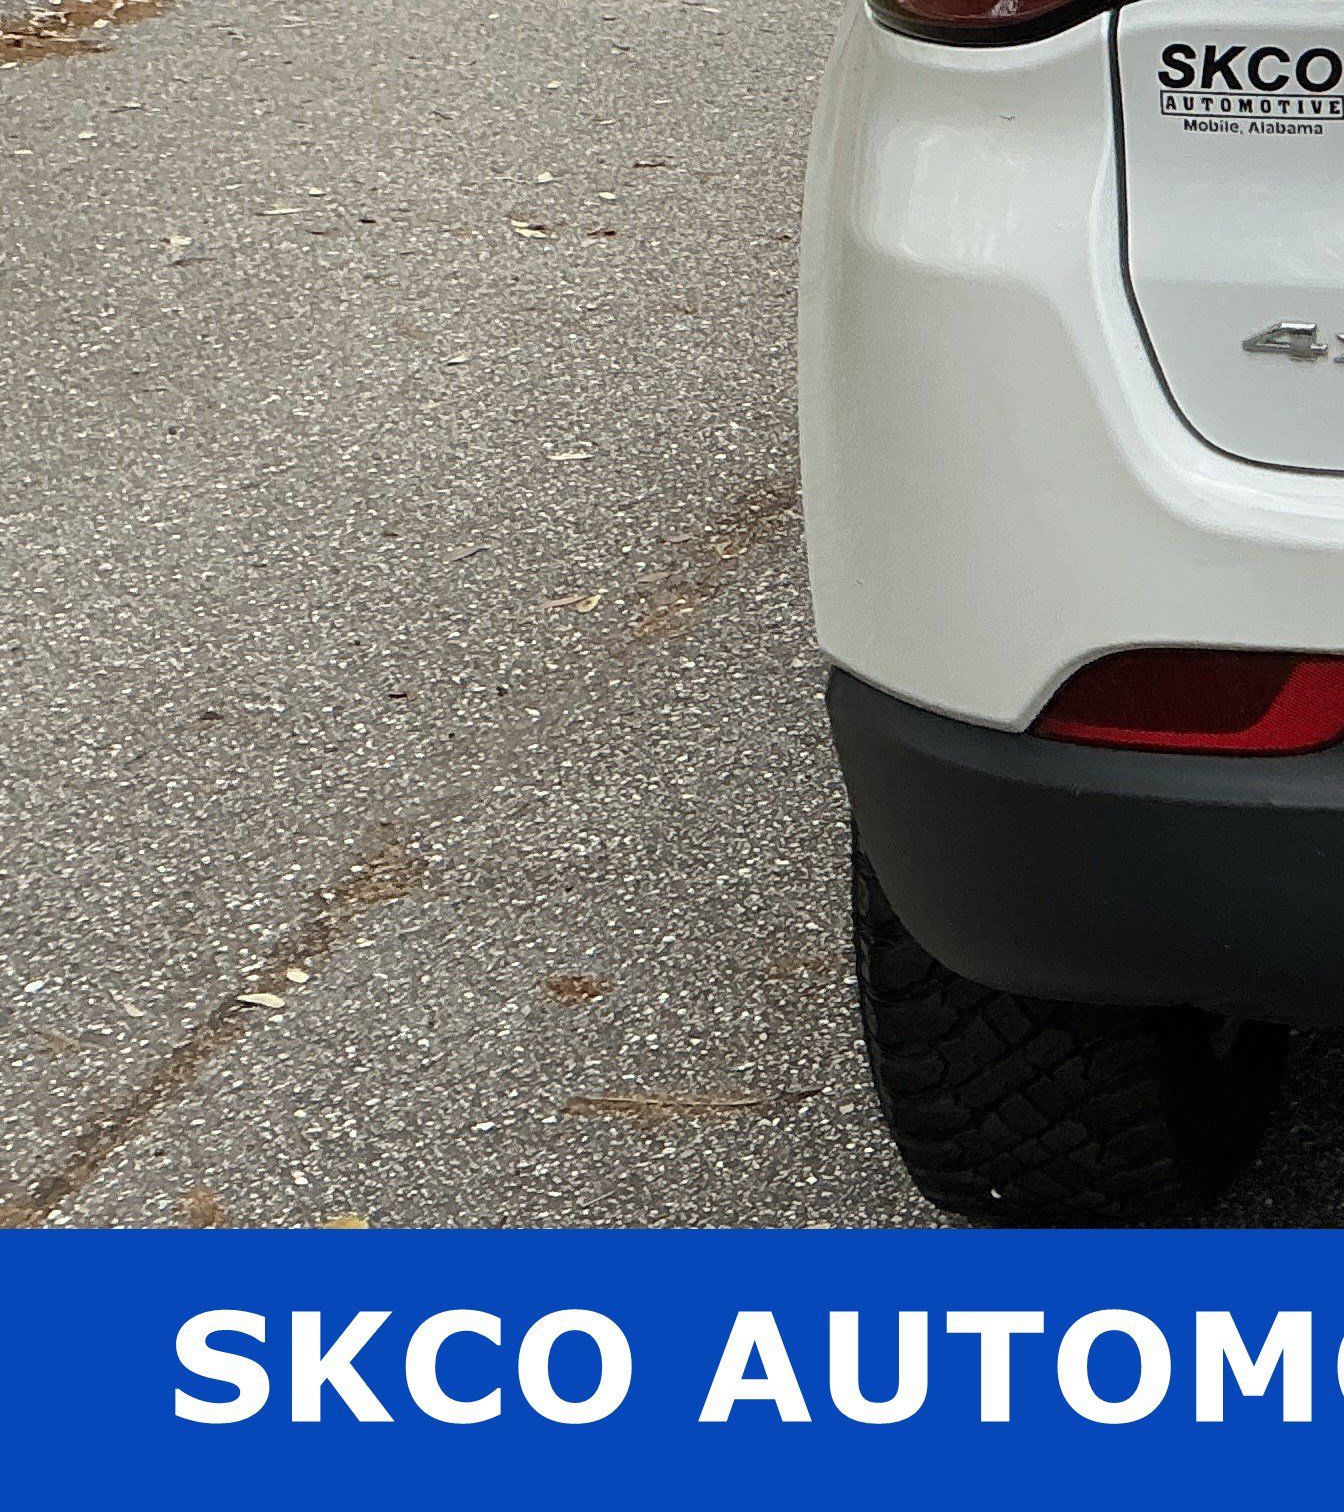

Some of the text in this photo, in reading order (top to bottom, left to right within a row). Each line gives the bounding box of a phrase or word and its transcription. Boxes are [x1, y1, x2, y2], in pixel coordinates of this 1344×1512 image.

[1157, 43, 1344, 92] SKCO
[1164, 94, 1342, 116] AUTOMOTIVE
[1183, 118, 1324, 136] Mobile, Alabama
